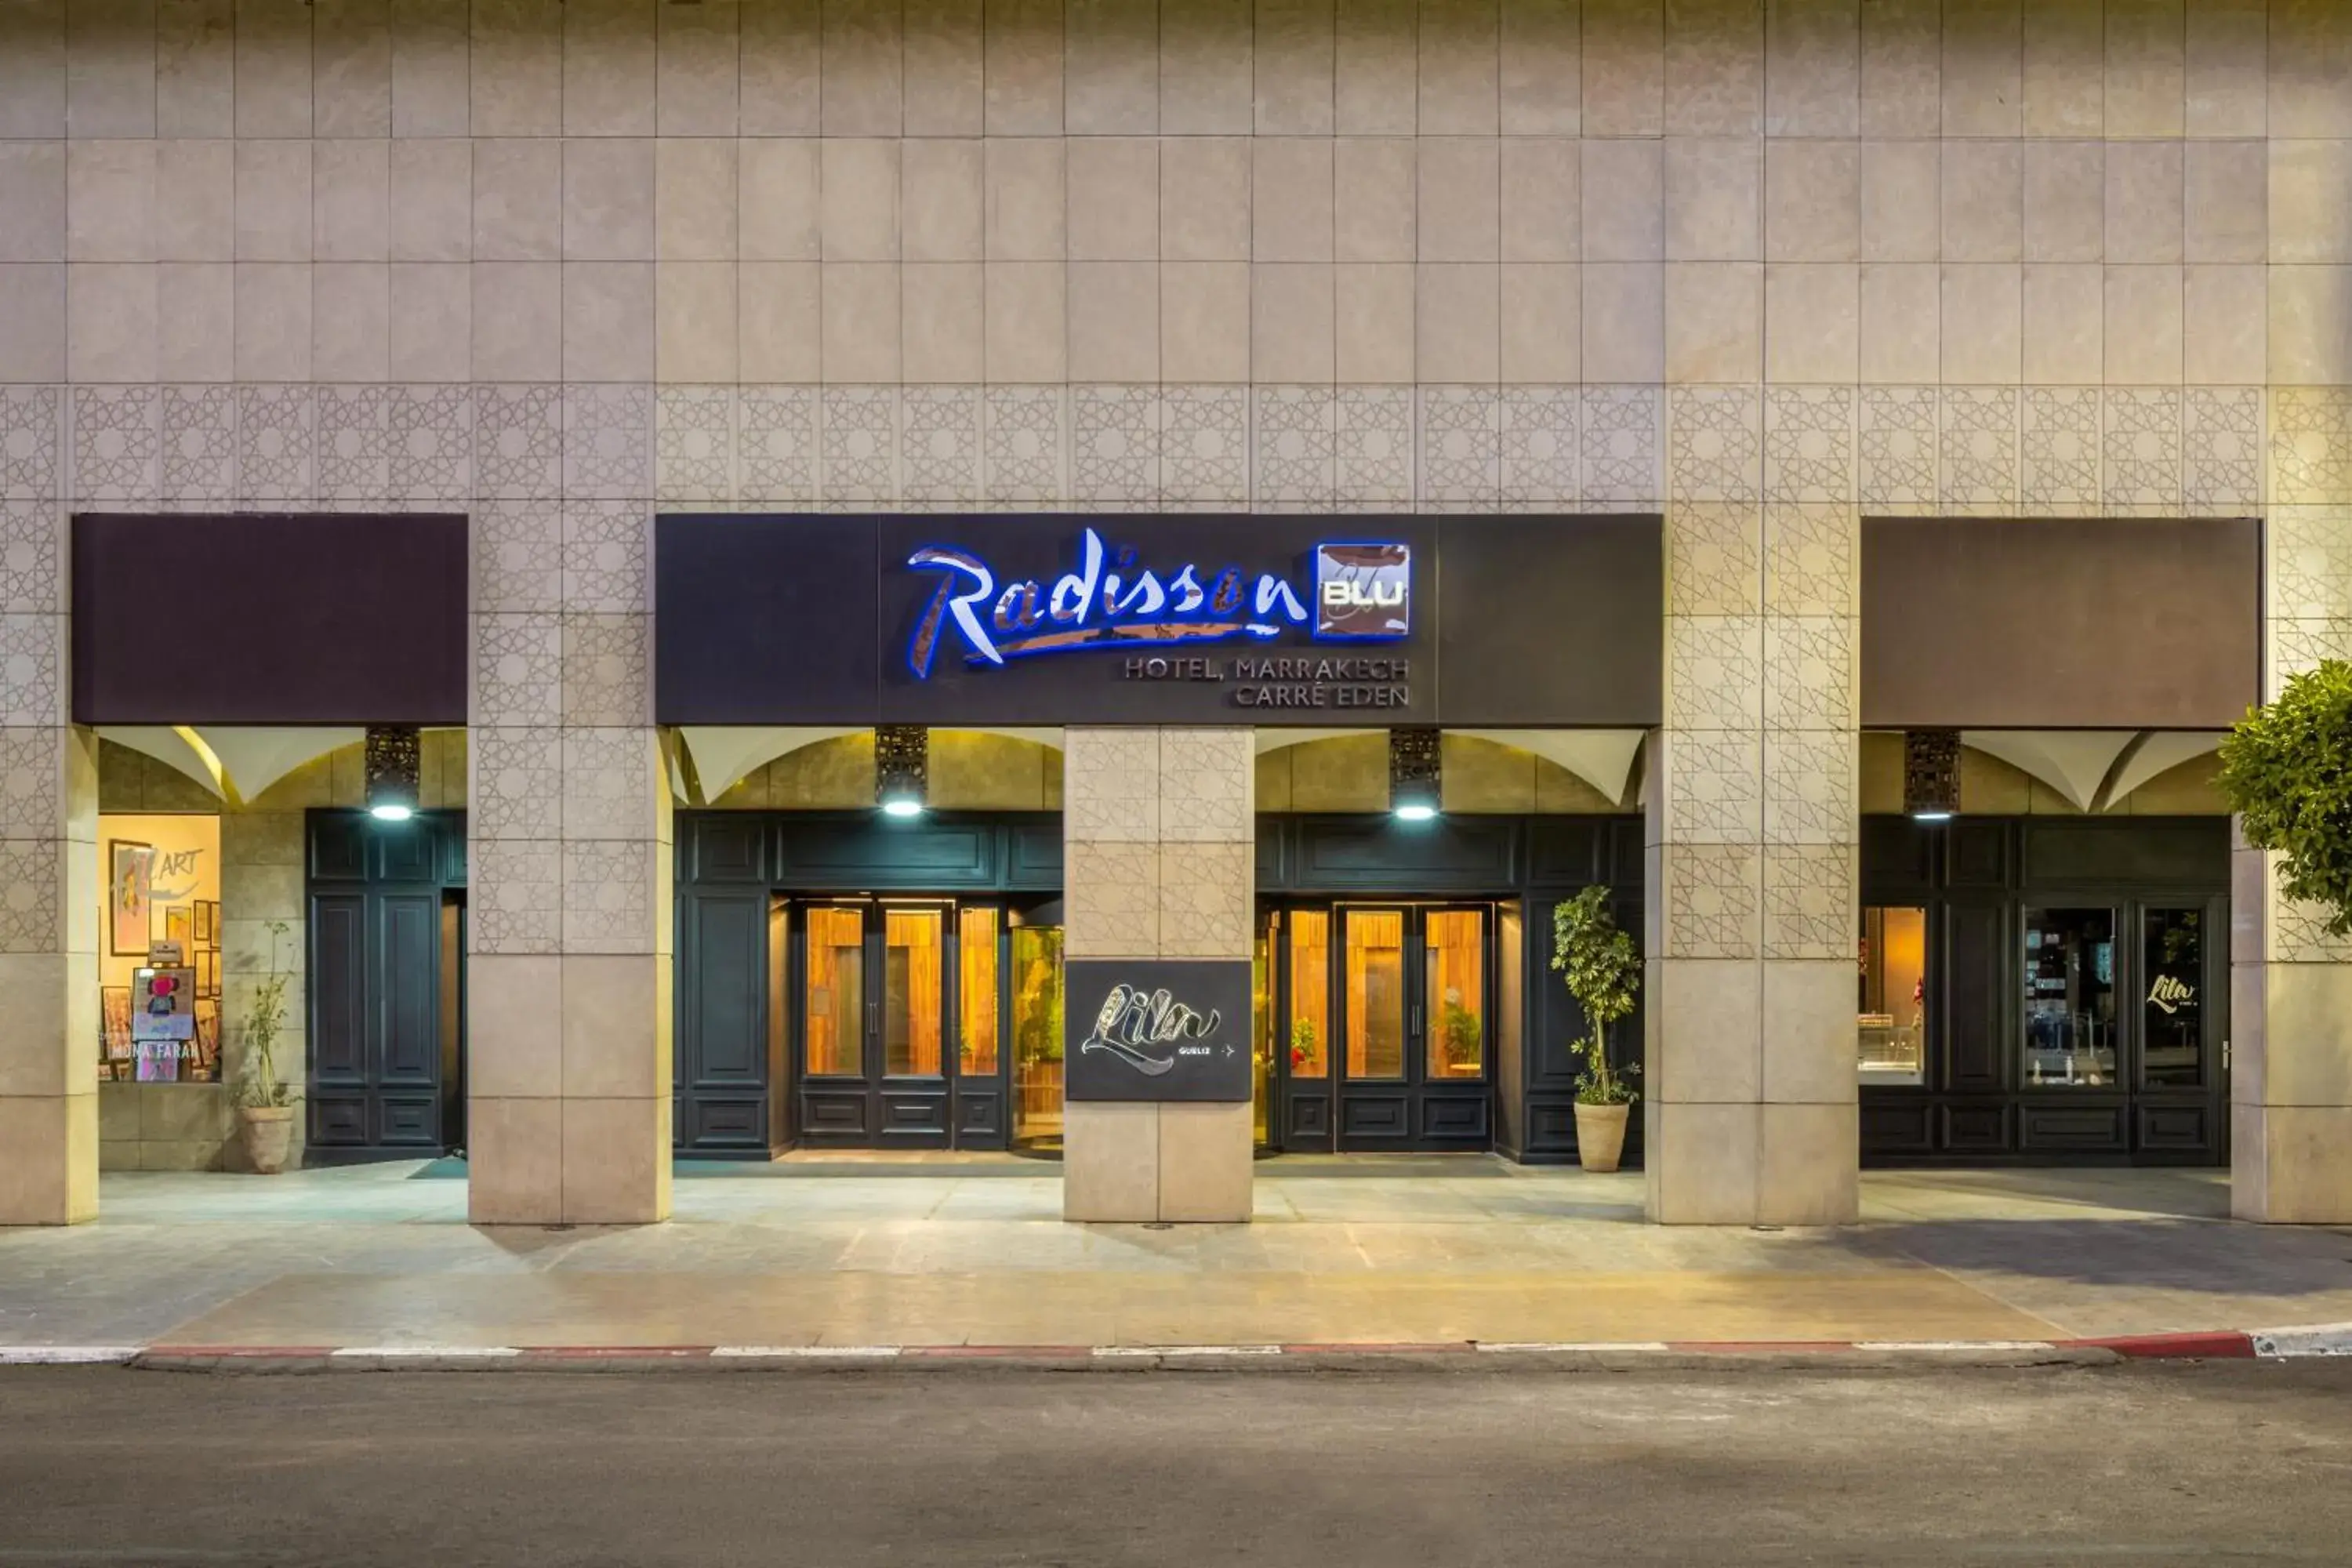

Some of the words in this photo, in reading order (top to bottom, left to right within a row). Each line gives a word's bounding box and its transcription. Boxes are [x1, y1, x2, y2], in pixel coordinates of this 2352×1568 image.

[907, 527, 1308, 679] Radisson
[1323, 580, 1403, 605] BLU
[1125, 659, 1225, 681] HOTEL,
[1236, 659, 1410, 679] MARRAKECH
[1236, 681, 1325, 706] CARRÉ
[1338, 686, 1410, 706] EDEN
